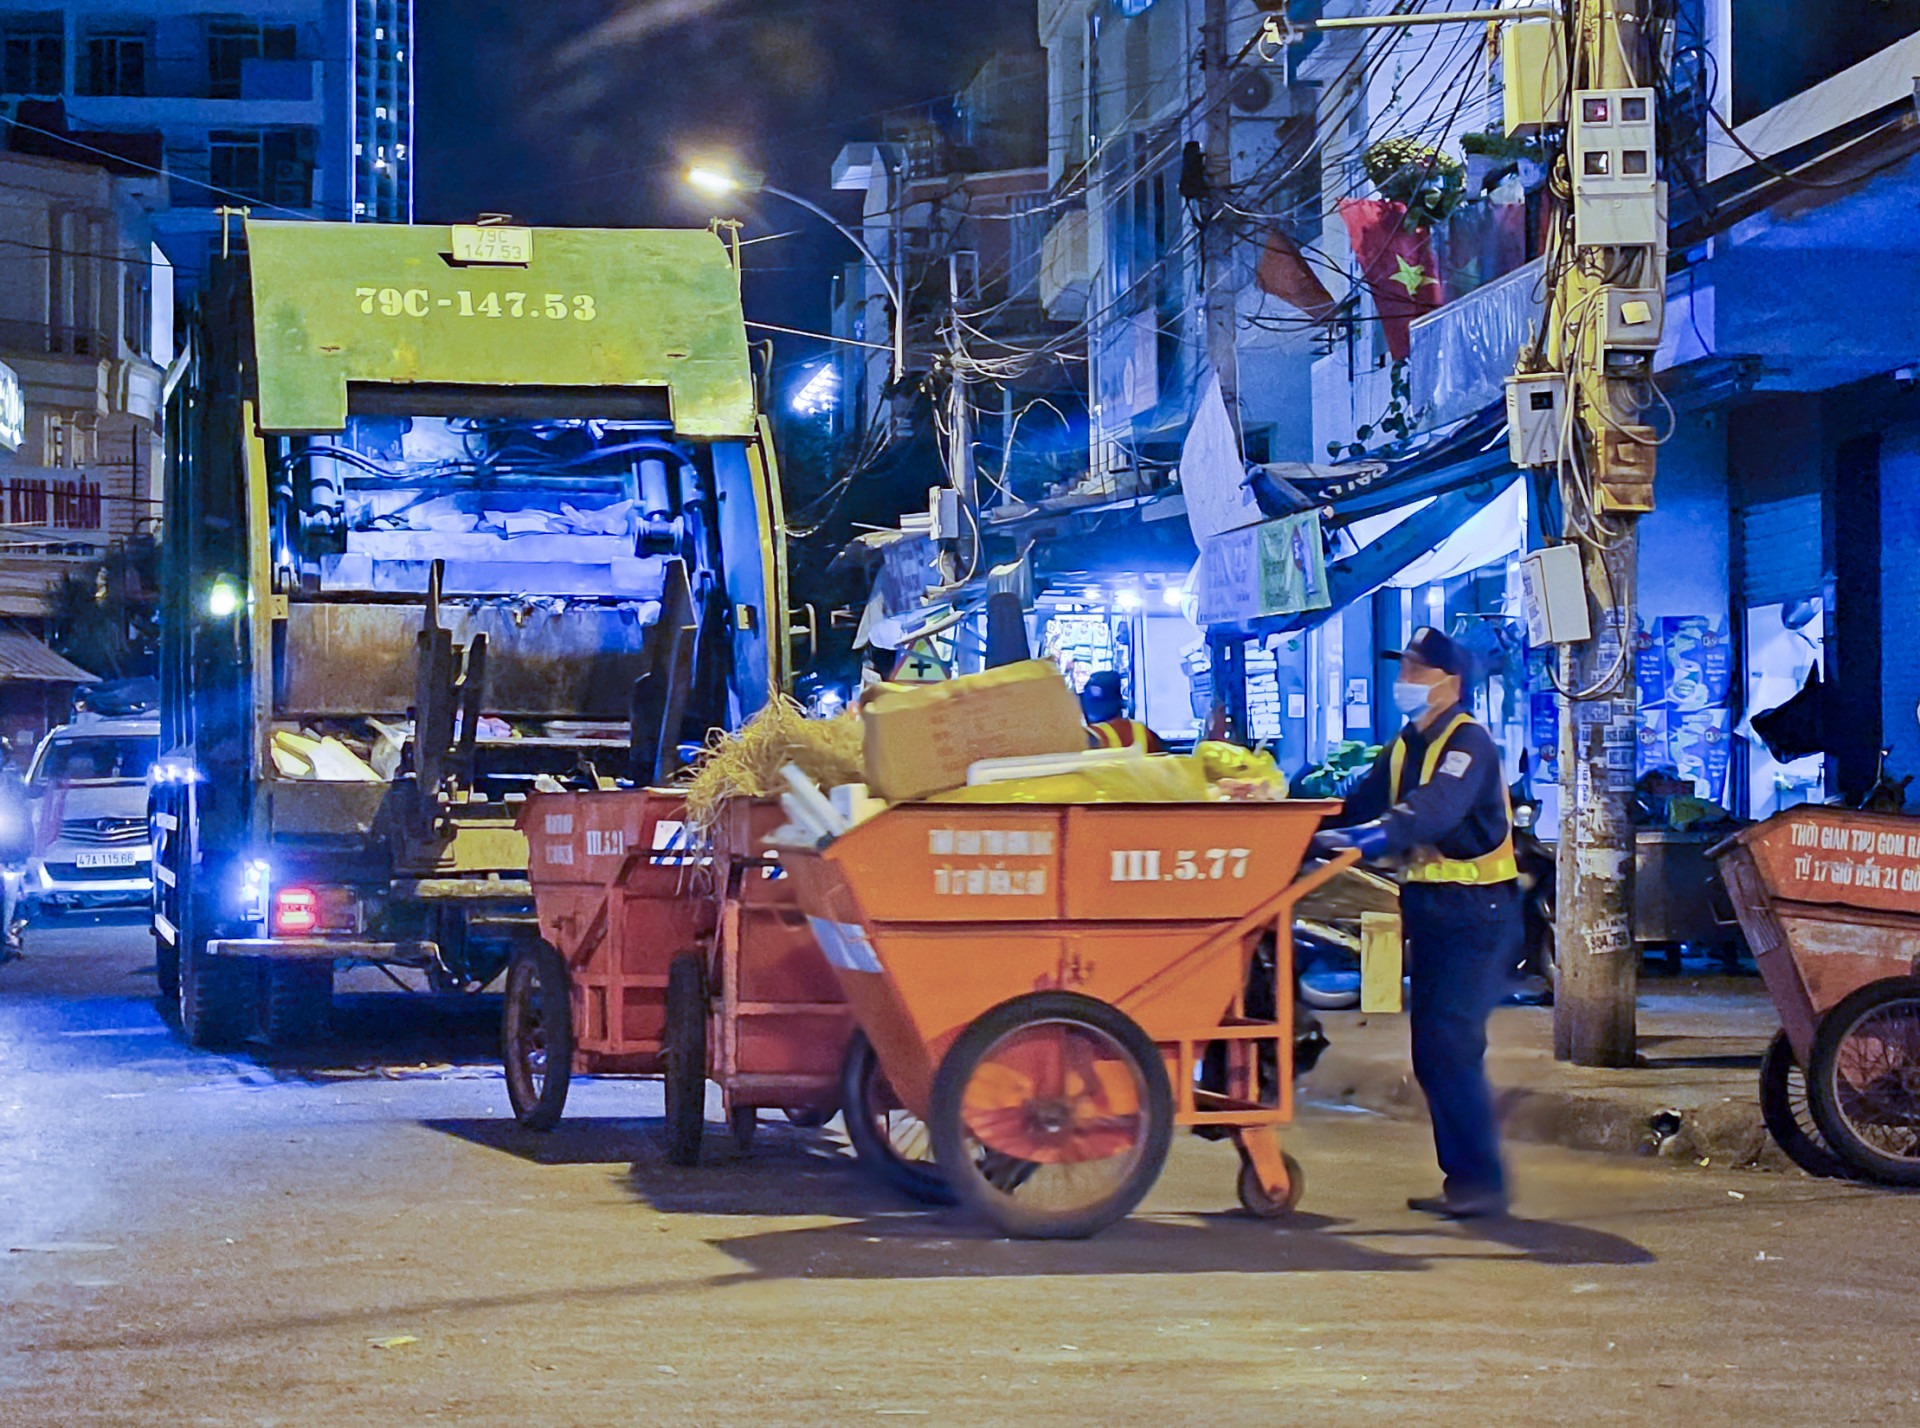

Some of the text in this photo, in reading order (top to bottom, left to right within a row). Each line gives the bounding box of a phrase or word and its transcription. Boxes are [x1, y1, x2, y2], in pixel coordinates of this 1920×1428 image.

[477, 230, 508, 243] 79C
[465, 244, 522, 260] 147.53
[356, 287, 597, 321] 79C-147.53
[1821, 827, 1849, 851] GIAN
[1877, 833, 1905, 857] GOM
[1110, 848, 1251, 882] III.5.77
[1813, 861, 1828, 882] 17
[1882, 867, 1898, 890] 21
